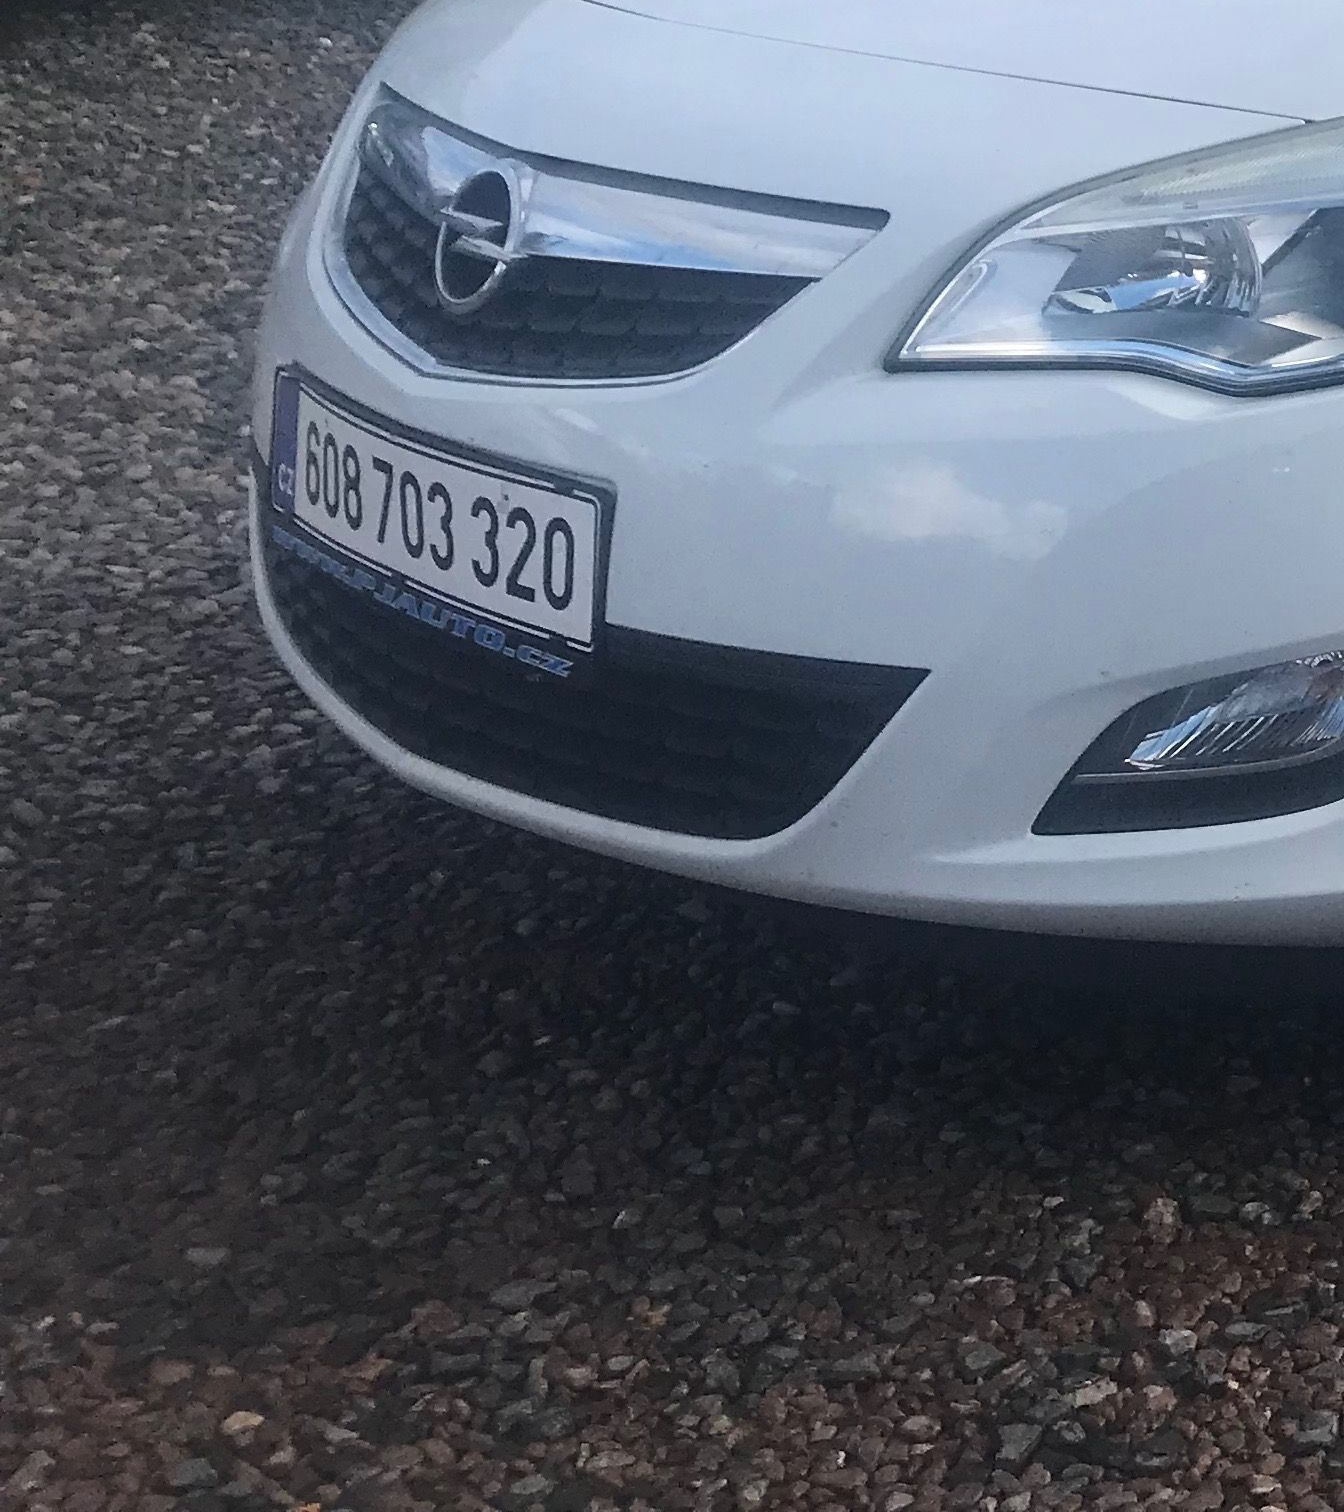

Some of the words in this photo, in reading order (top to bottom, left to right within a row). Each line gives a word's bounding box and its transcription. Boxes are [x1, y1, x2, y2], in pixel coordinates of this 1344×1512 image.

[278, 463, 294, 496] CZ
[305, 420, 364, 531] 608
[371, 454, 455, 571] 703
[471, 495, 575, 611] 320
